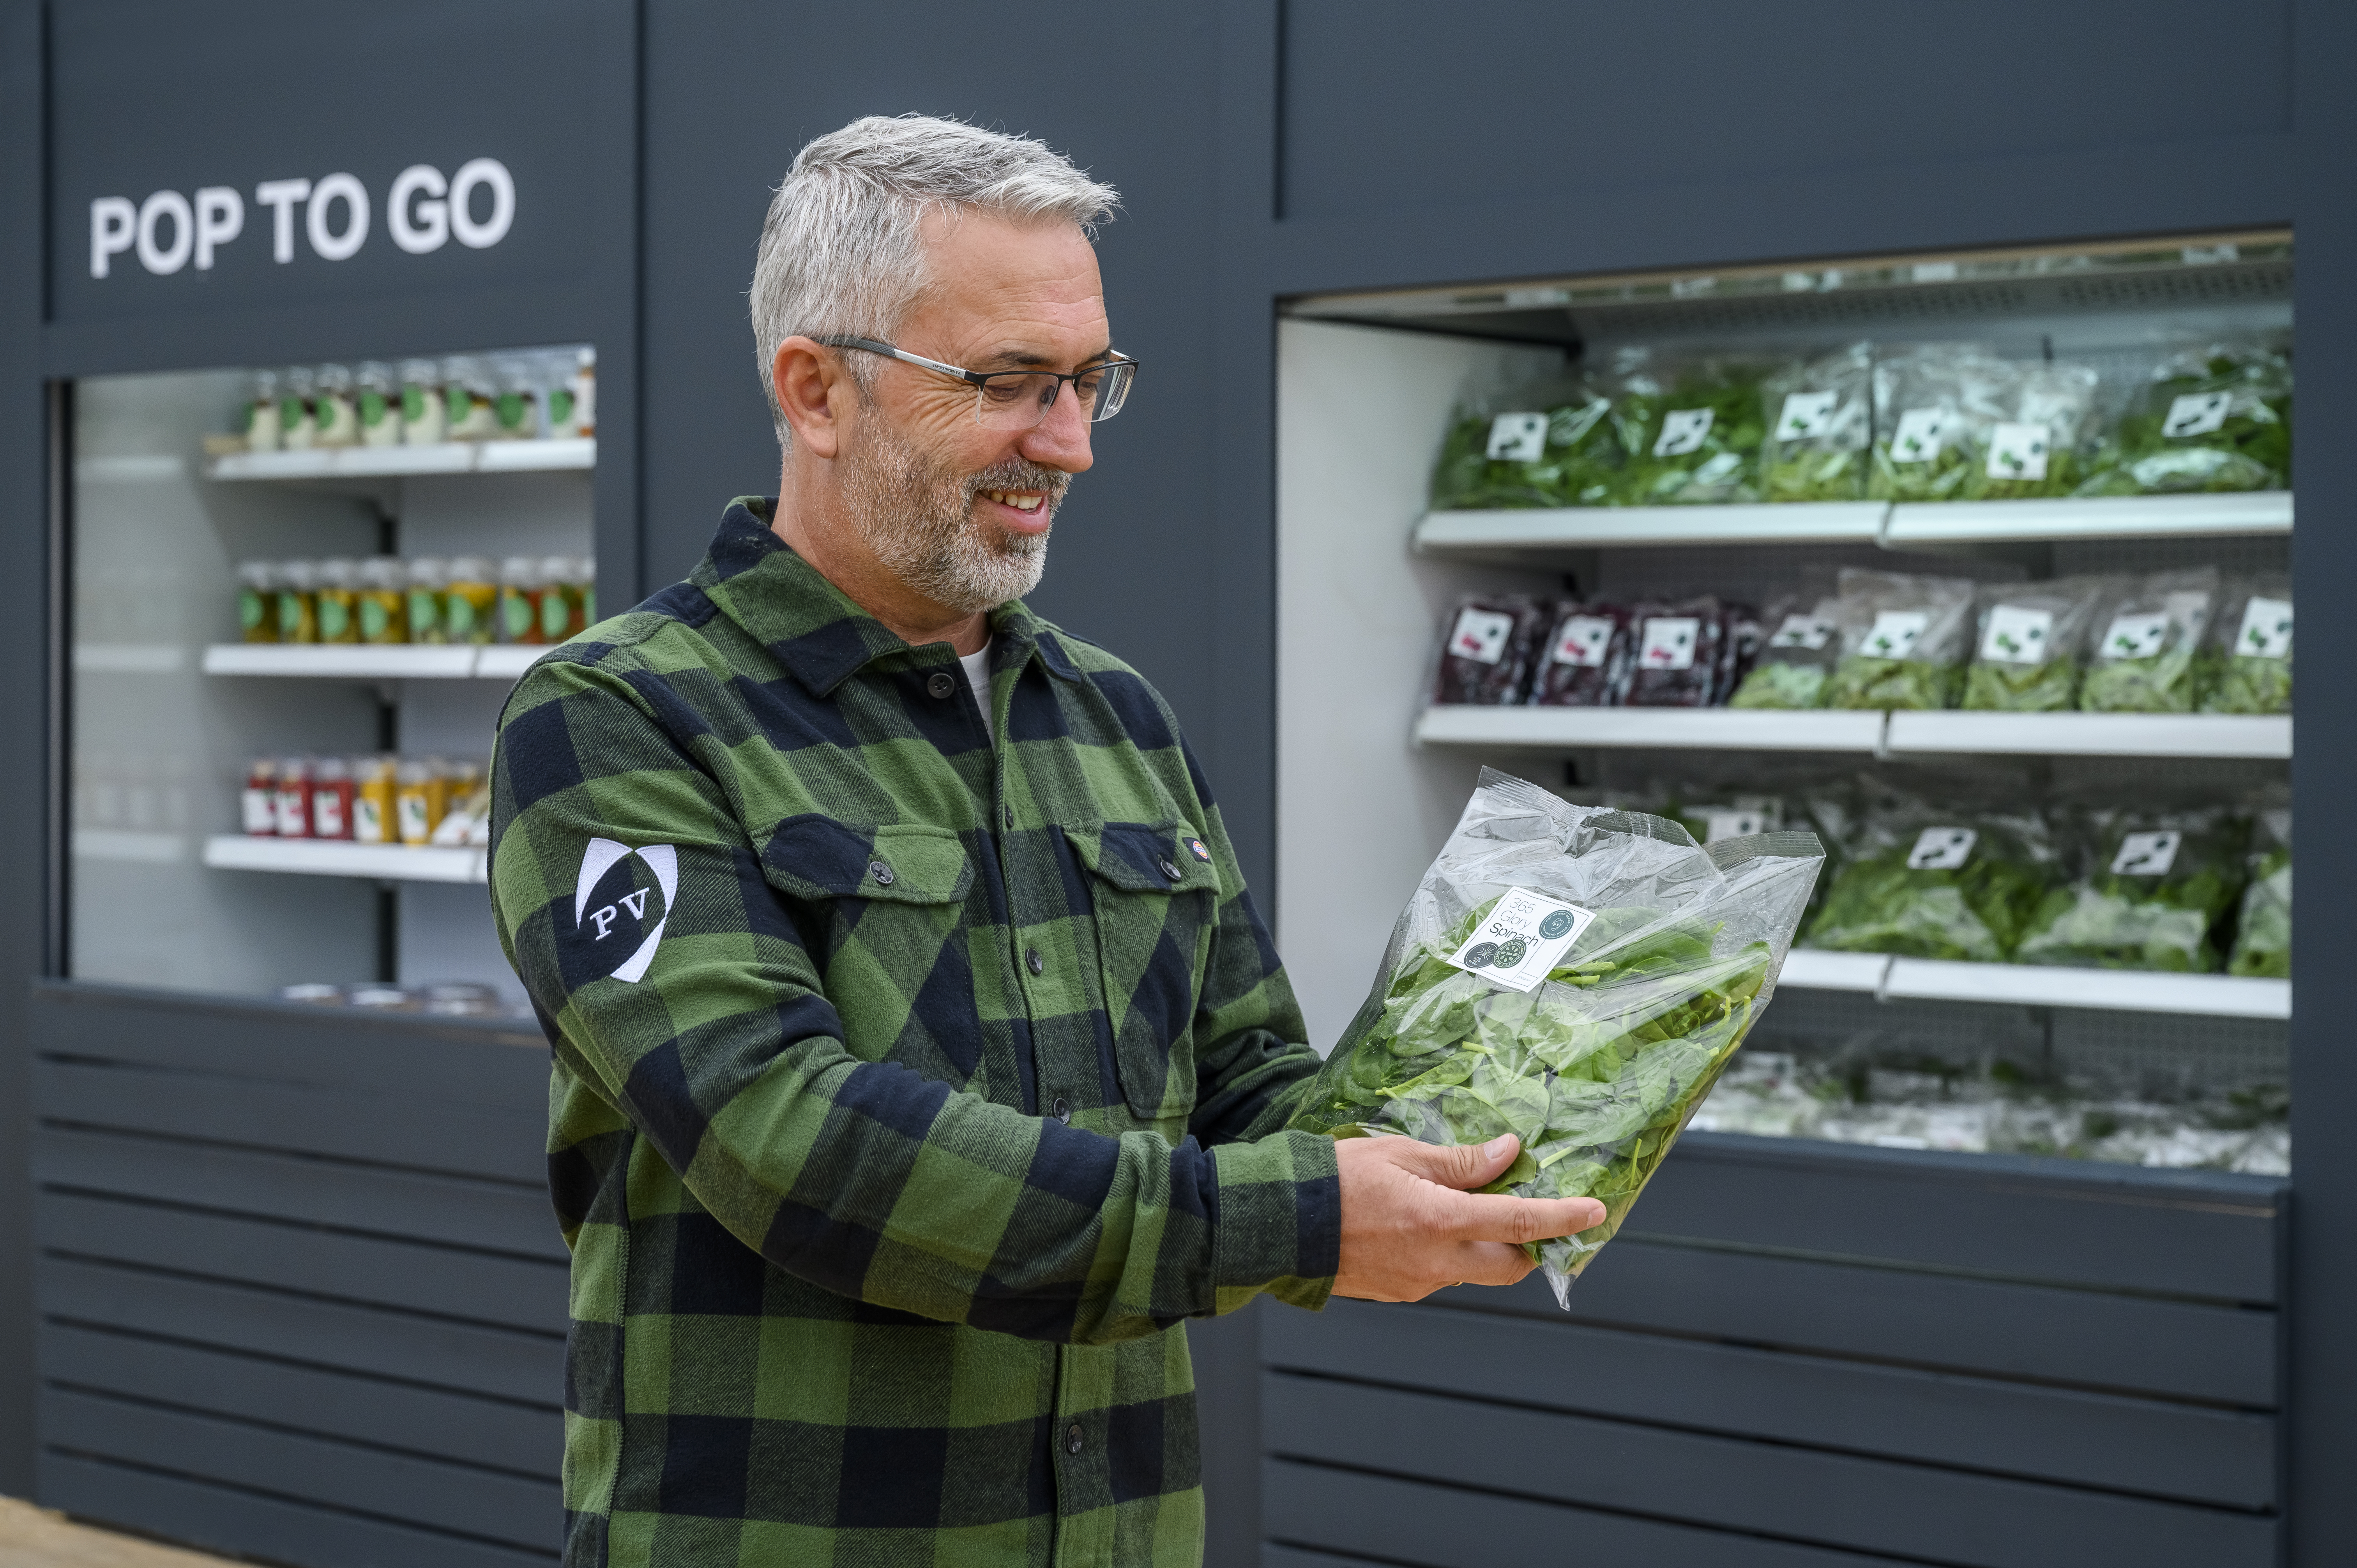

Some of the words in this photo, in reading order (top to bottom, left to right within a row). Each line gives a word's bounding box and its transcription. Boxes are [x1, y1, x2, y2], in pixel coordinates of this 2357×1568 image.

[90, 185, 245, 279] POP
[256, 172, 371, 264] TO
[387, 157, 516, 254] GO
[1509, 897, 1536, 914] 365
[1500, 910, 1532, 930] Glory
[1489, 923, 1539, 947] Spinach
